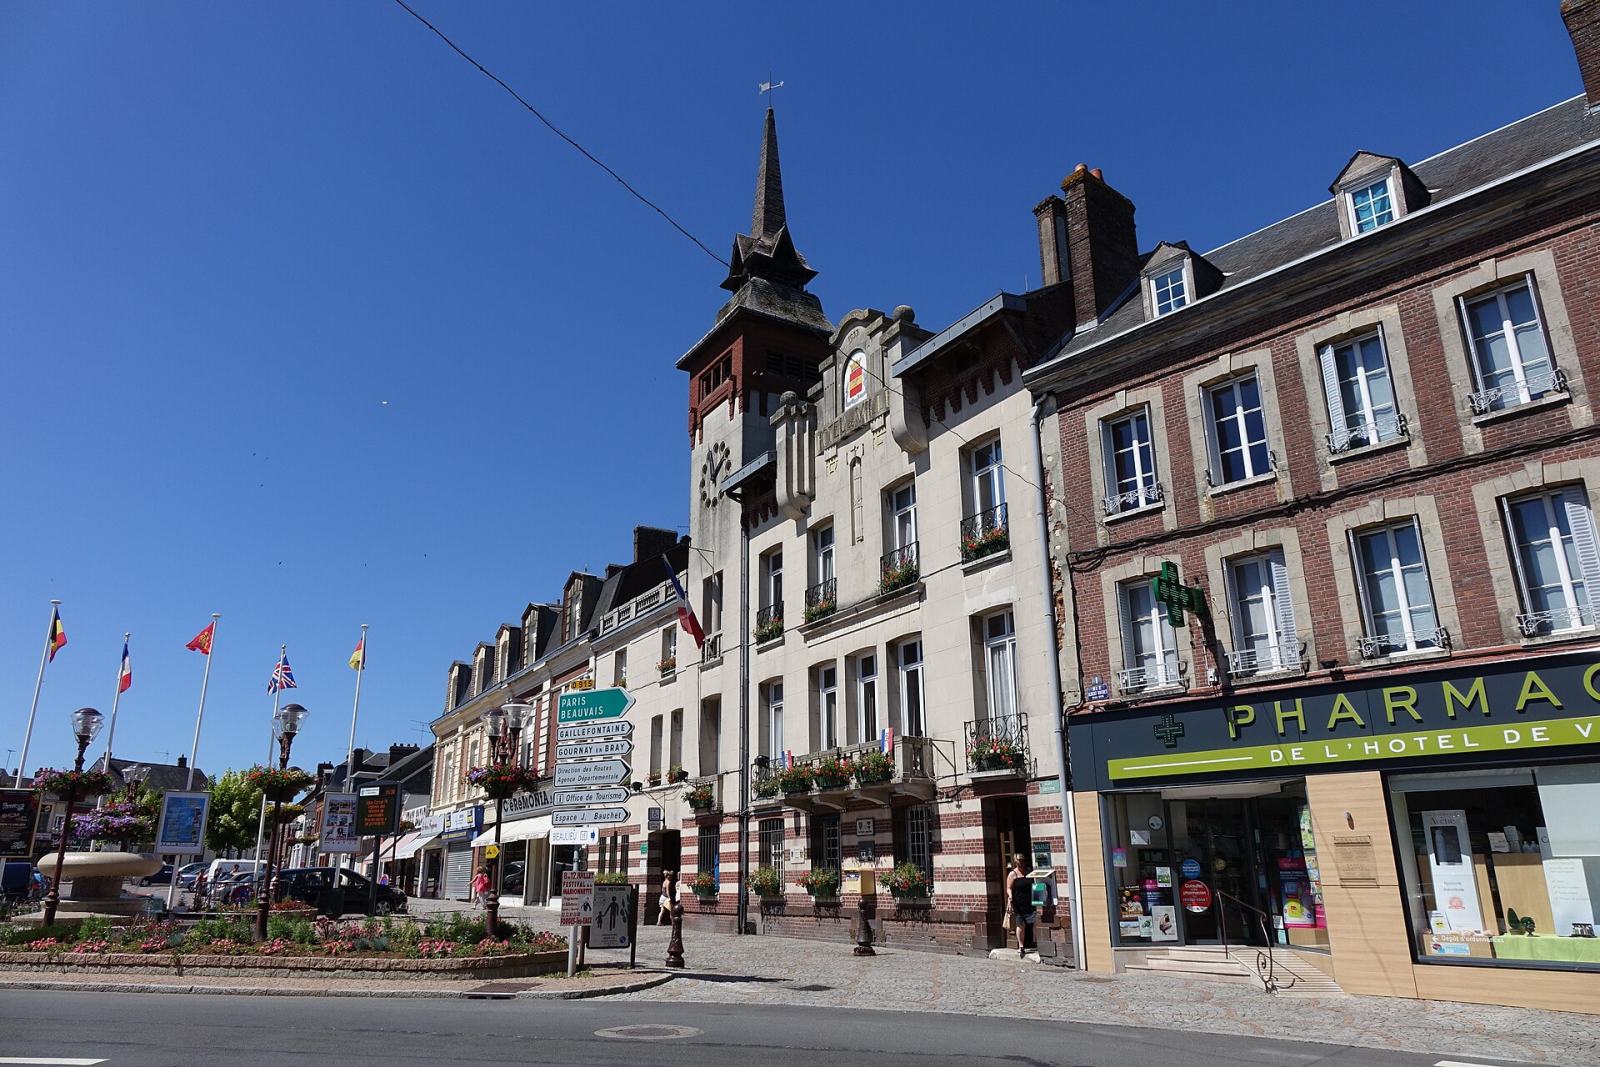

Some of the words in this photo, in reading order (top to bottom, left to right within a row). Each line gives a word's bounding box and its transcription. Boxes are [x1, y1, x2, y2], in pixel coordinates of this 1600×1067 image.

[572, 681, 577, 689] D
[579, 680, 593, 688] 915
[561, 696, 587, 707] PARIS
[561, 706, 604, 719] BEAUVAIS
[559, 724, 626, 738] GAILLEFONTAINE
[558, 746, 593, 756] GOURNAY
[604, 743, 625, 753] BRAY
[1270, 748, 1305, 763] DE
[1325, 733, 1479, 758] L'HOTEL
[1504, 727, 1550, 744] DE
[557, 767, 581, 775] Direction
[557, 776, 576, 784] Agence
[577, 774, 619, 783] Départementale
[565, 794, 584, 802] Office
[596, 792, 623, 800] Tourisme
[555, 815, 577, 823] Espace
[594, 812, 622, 820] Bauchet
